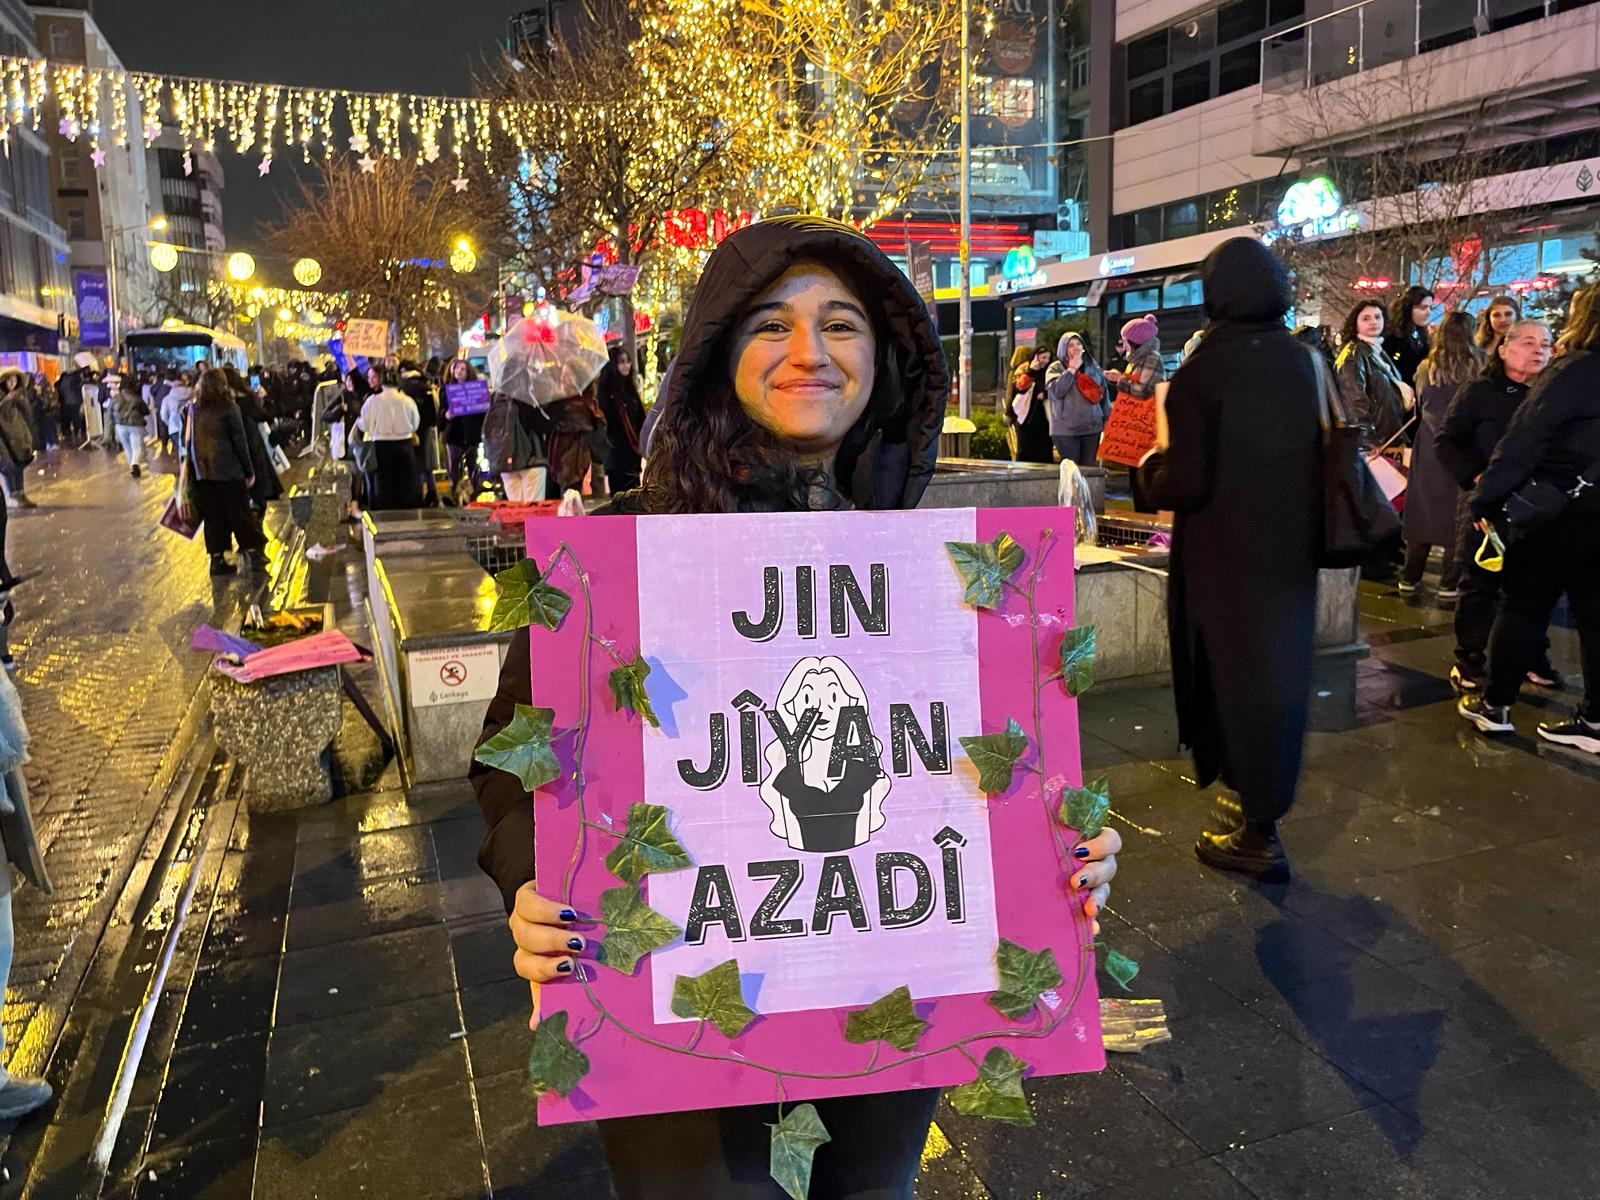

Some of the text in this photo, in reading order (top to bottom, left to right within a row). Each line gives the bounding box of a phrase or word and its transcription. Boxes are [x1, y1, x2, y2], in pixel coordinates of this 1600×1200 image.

[731, 563, 891, 642] JIN
[677, 689, 952, 790] JÎYAN
[684, 825, 968, 945] AZADÎ
